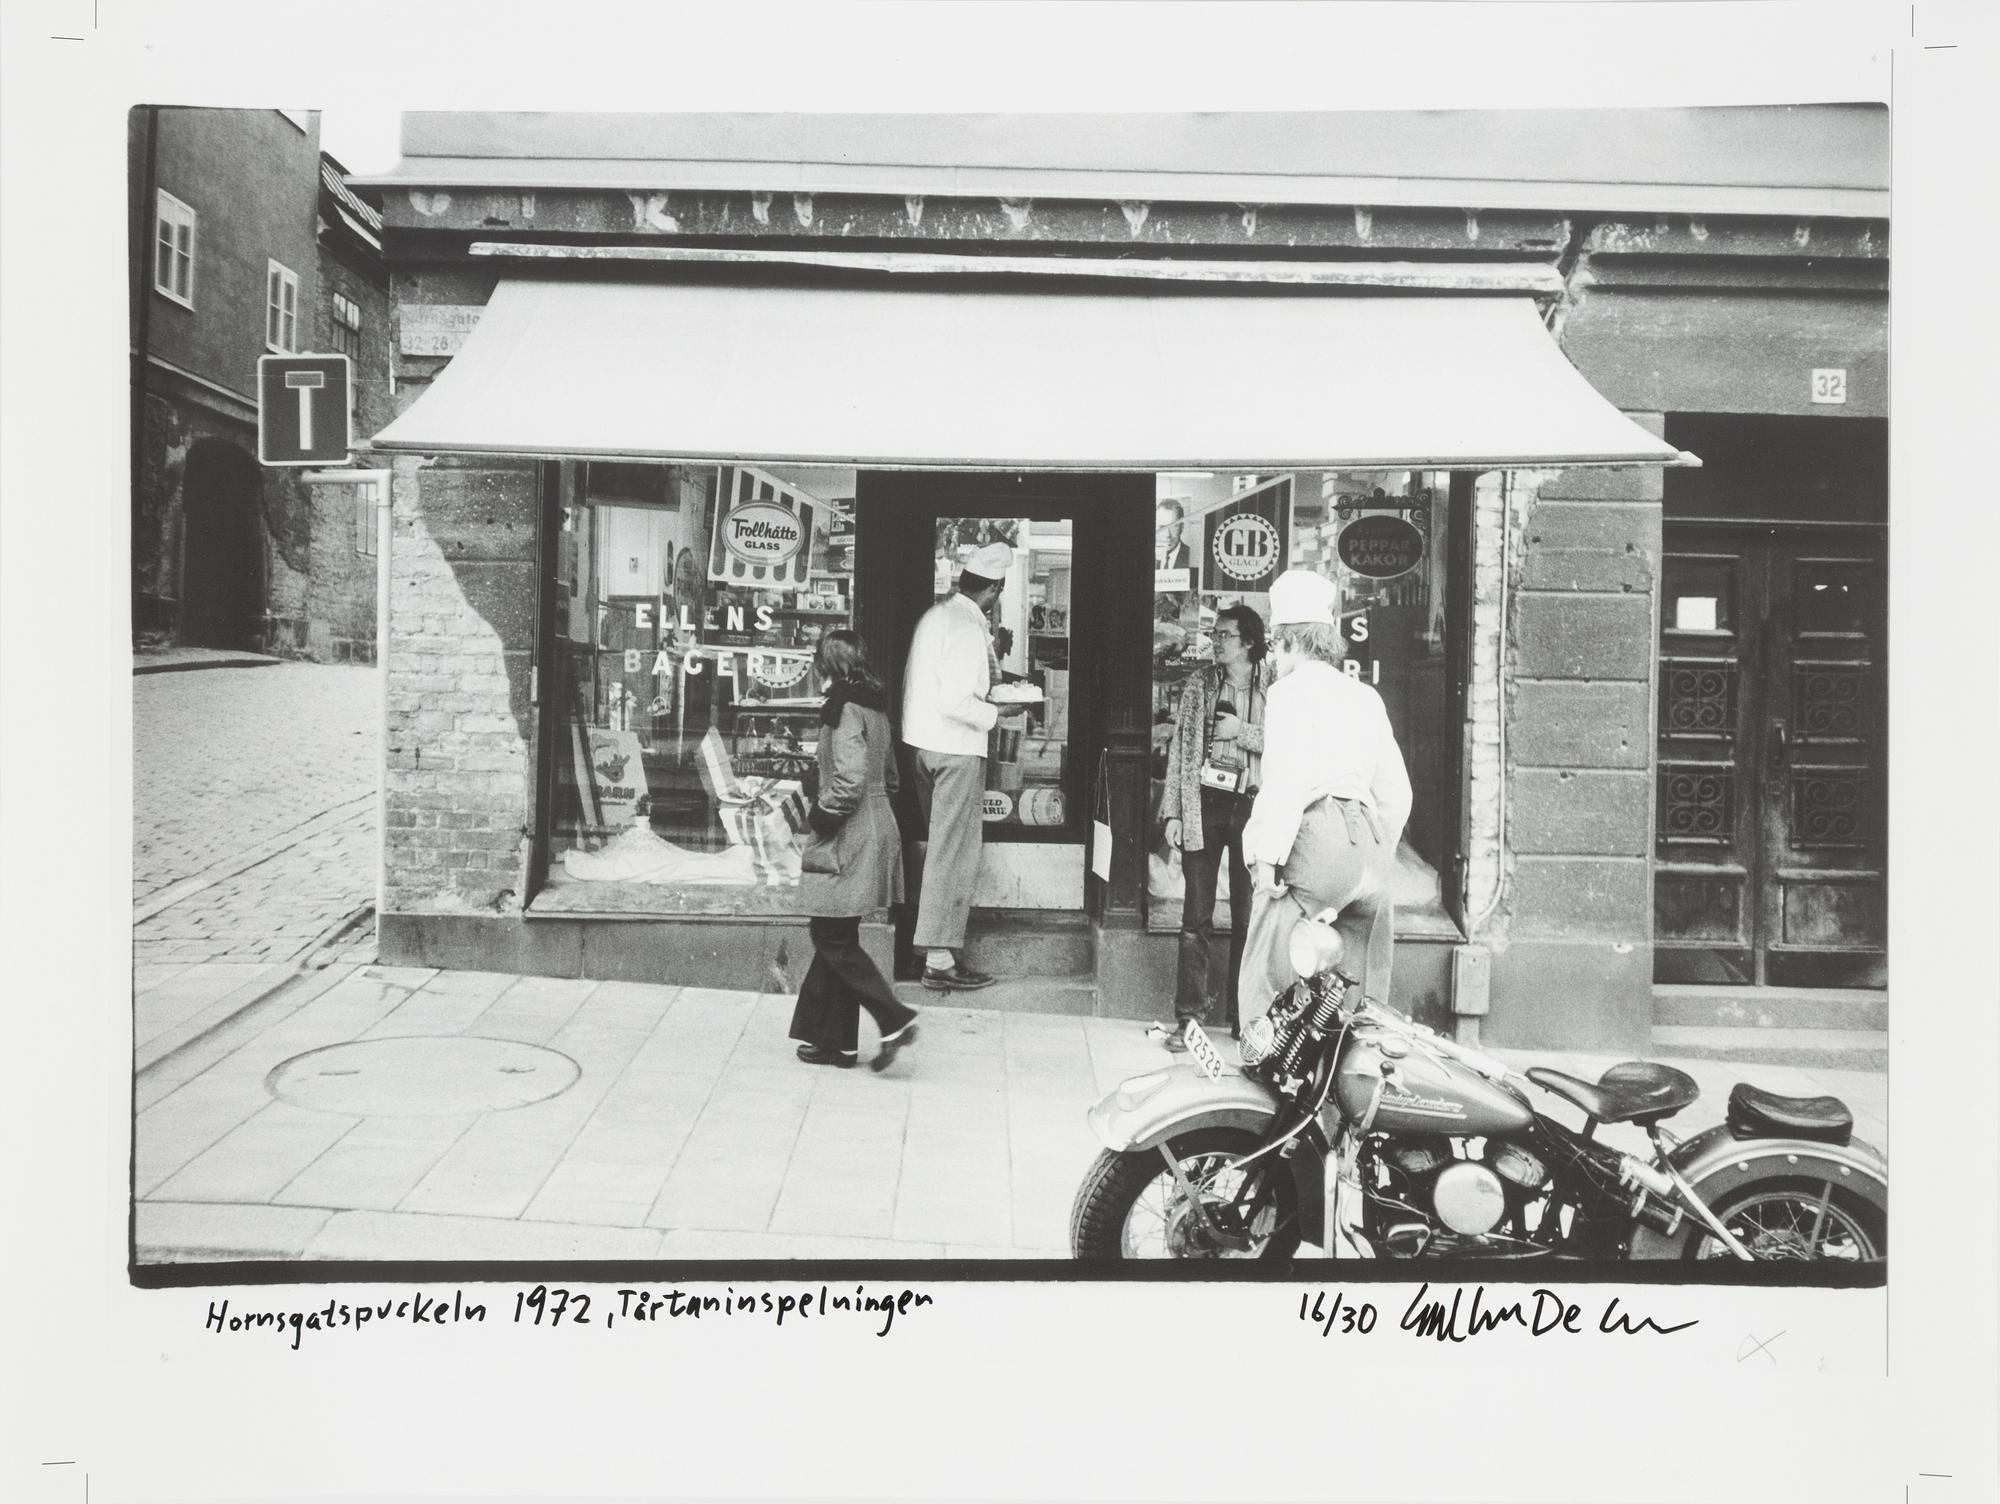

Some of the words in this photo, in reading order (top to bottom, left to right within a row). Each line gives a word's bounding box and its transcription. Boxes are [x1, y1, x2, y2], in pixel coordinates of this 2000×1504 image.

[1817, 375, 1842, 398] 32
[731, 517, 798, 541] Trollhätte
[744, 541, 781, 551] GLASS
[1223, 528, 1268, 557] GB
[1349, 539, 1410, 552] PEPPAR
[1229, 559, 1261, 567] GLACE
[1350, 553, 1409, 566] KAKOR
[635, 603, 774, 631] ELLENS
[624, 648, 783, 677] BAGERI
[982, 798, 1003, 806] ULD
[982, 806, 1007, 815] ARIE
[205, 1289, 487, 1351] Hornsgatspuckeln
[1299, 1290, 1378, 1338] 16/30
